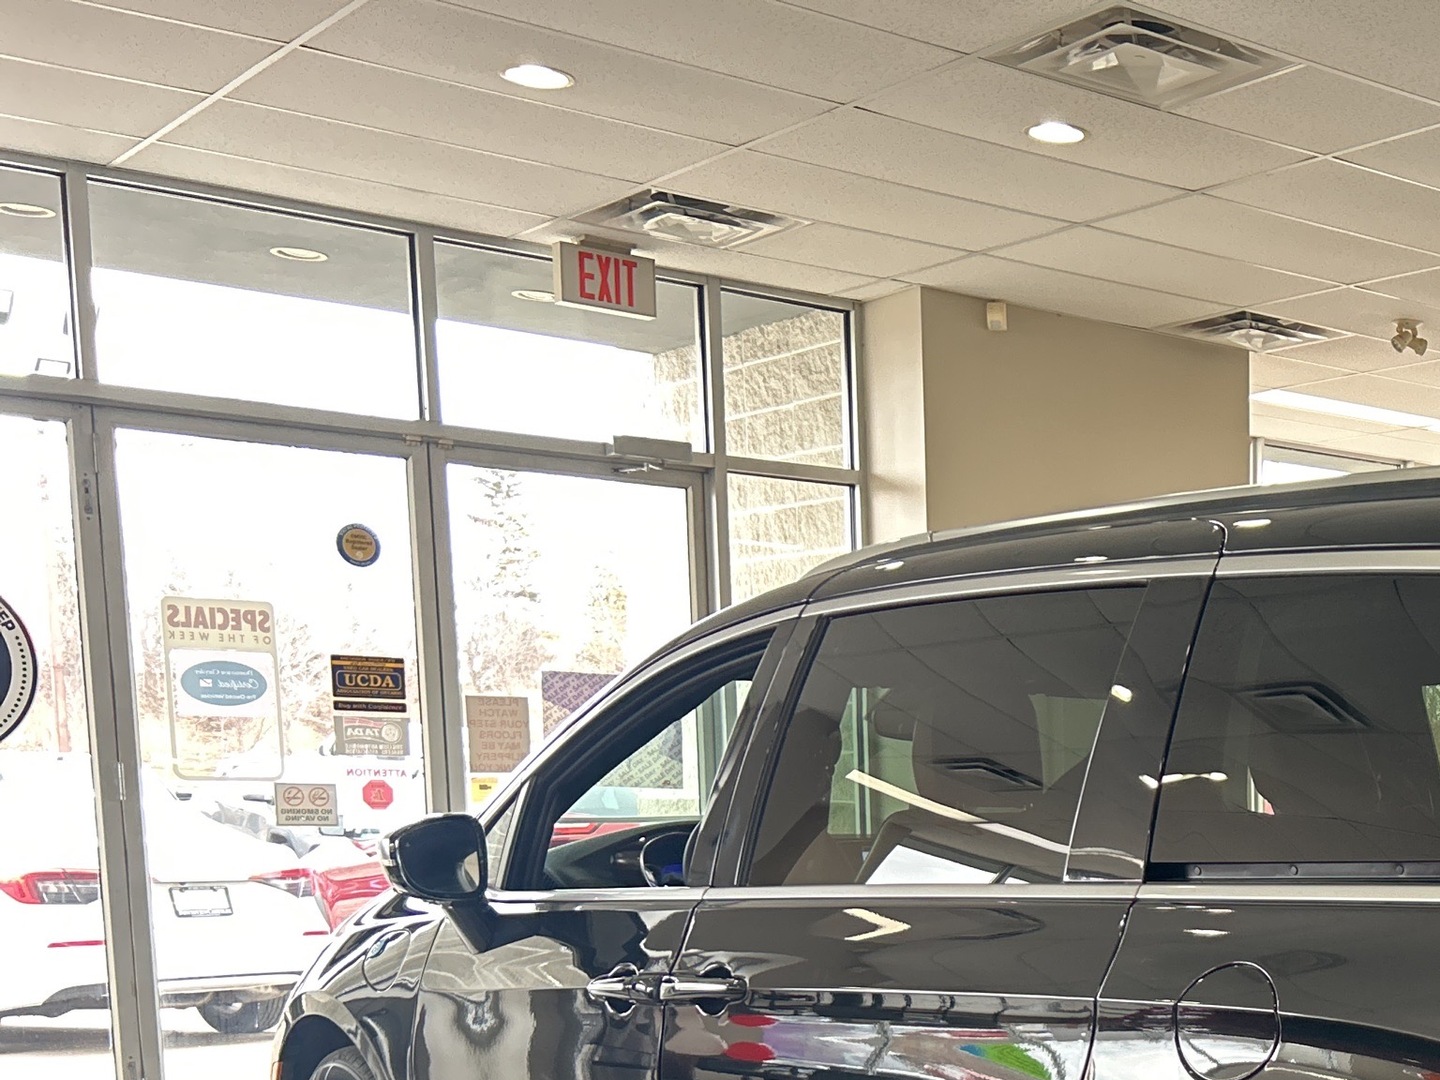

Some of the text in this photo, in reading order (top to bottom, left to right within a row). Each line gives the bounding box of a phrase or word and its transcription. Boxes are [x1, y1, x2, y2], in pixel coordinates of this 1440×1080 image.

[578, 251, 638, 307] EXIT
[0, 607, 15, 631] EP
[343, 673, 396, 688] UCDA
